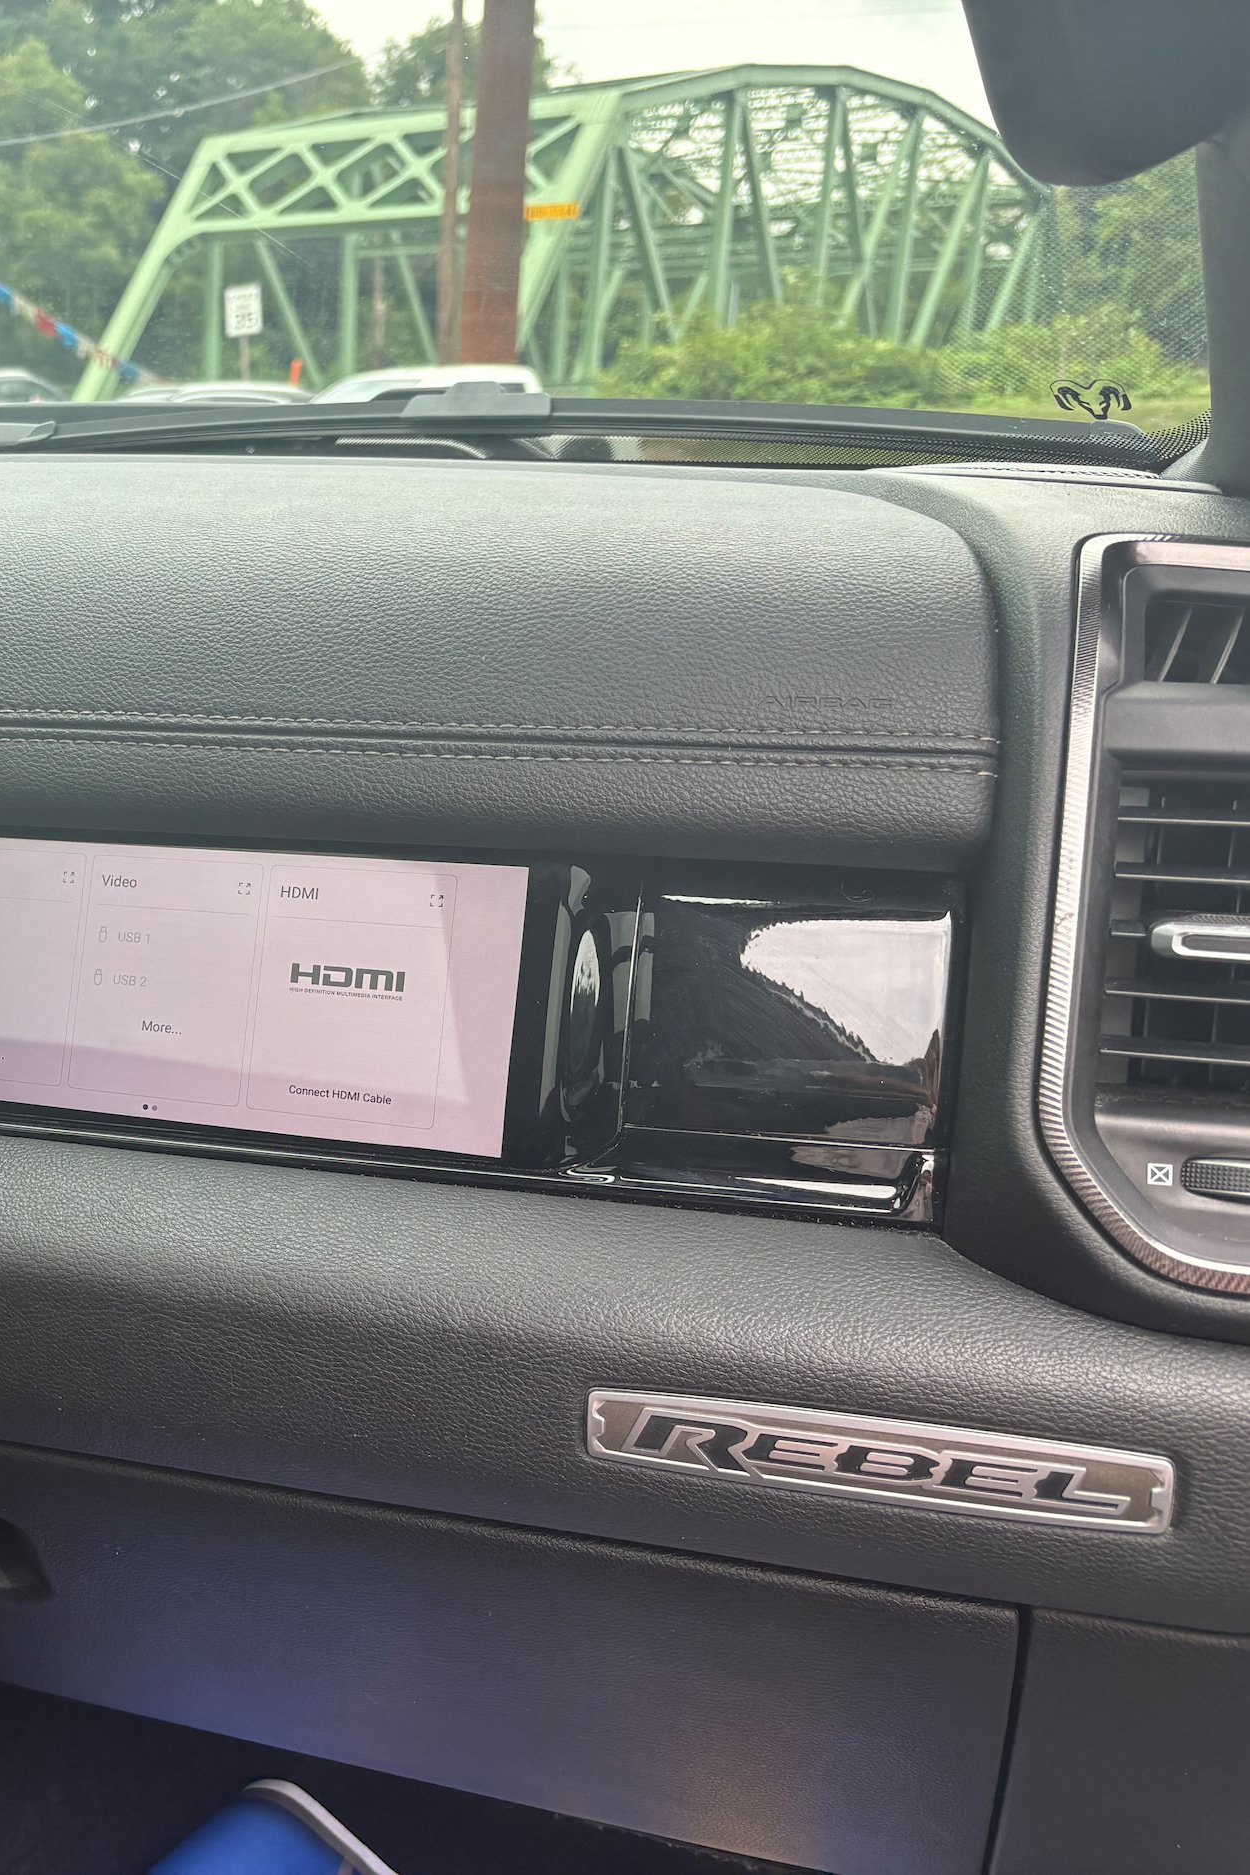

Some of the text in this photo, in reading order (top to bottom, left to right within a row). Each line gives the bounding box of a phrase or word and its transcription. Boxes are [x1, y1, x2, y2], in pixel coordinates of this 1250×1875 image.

[758, 696, 892, 709] AIRBAG
[102, 874, 137, 888] Video
[280, 886, 319, 900] HDMI
[118, 931, 150, 944] USB 1
[113, 974, 147, 987] USB 2
[290, 963, 406, 992] HDMI
[336, 991, 371, 999] MULTIMEDIA
[141, 1020, 182, 1035] More...
[288, 1084, 392, 1105] Connect HDMI Cable
[621, 1407, 1131, 1515] REBEL
